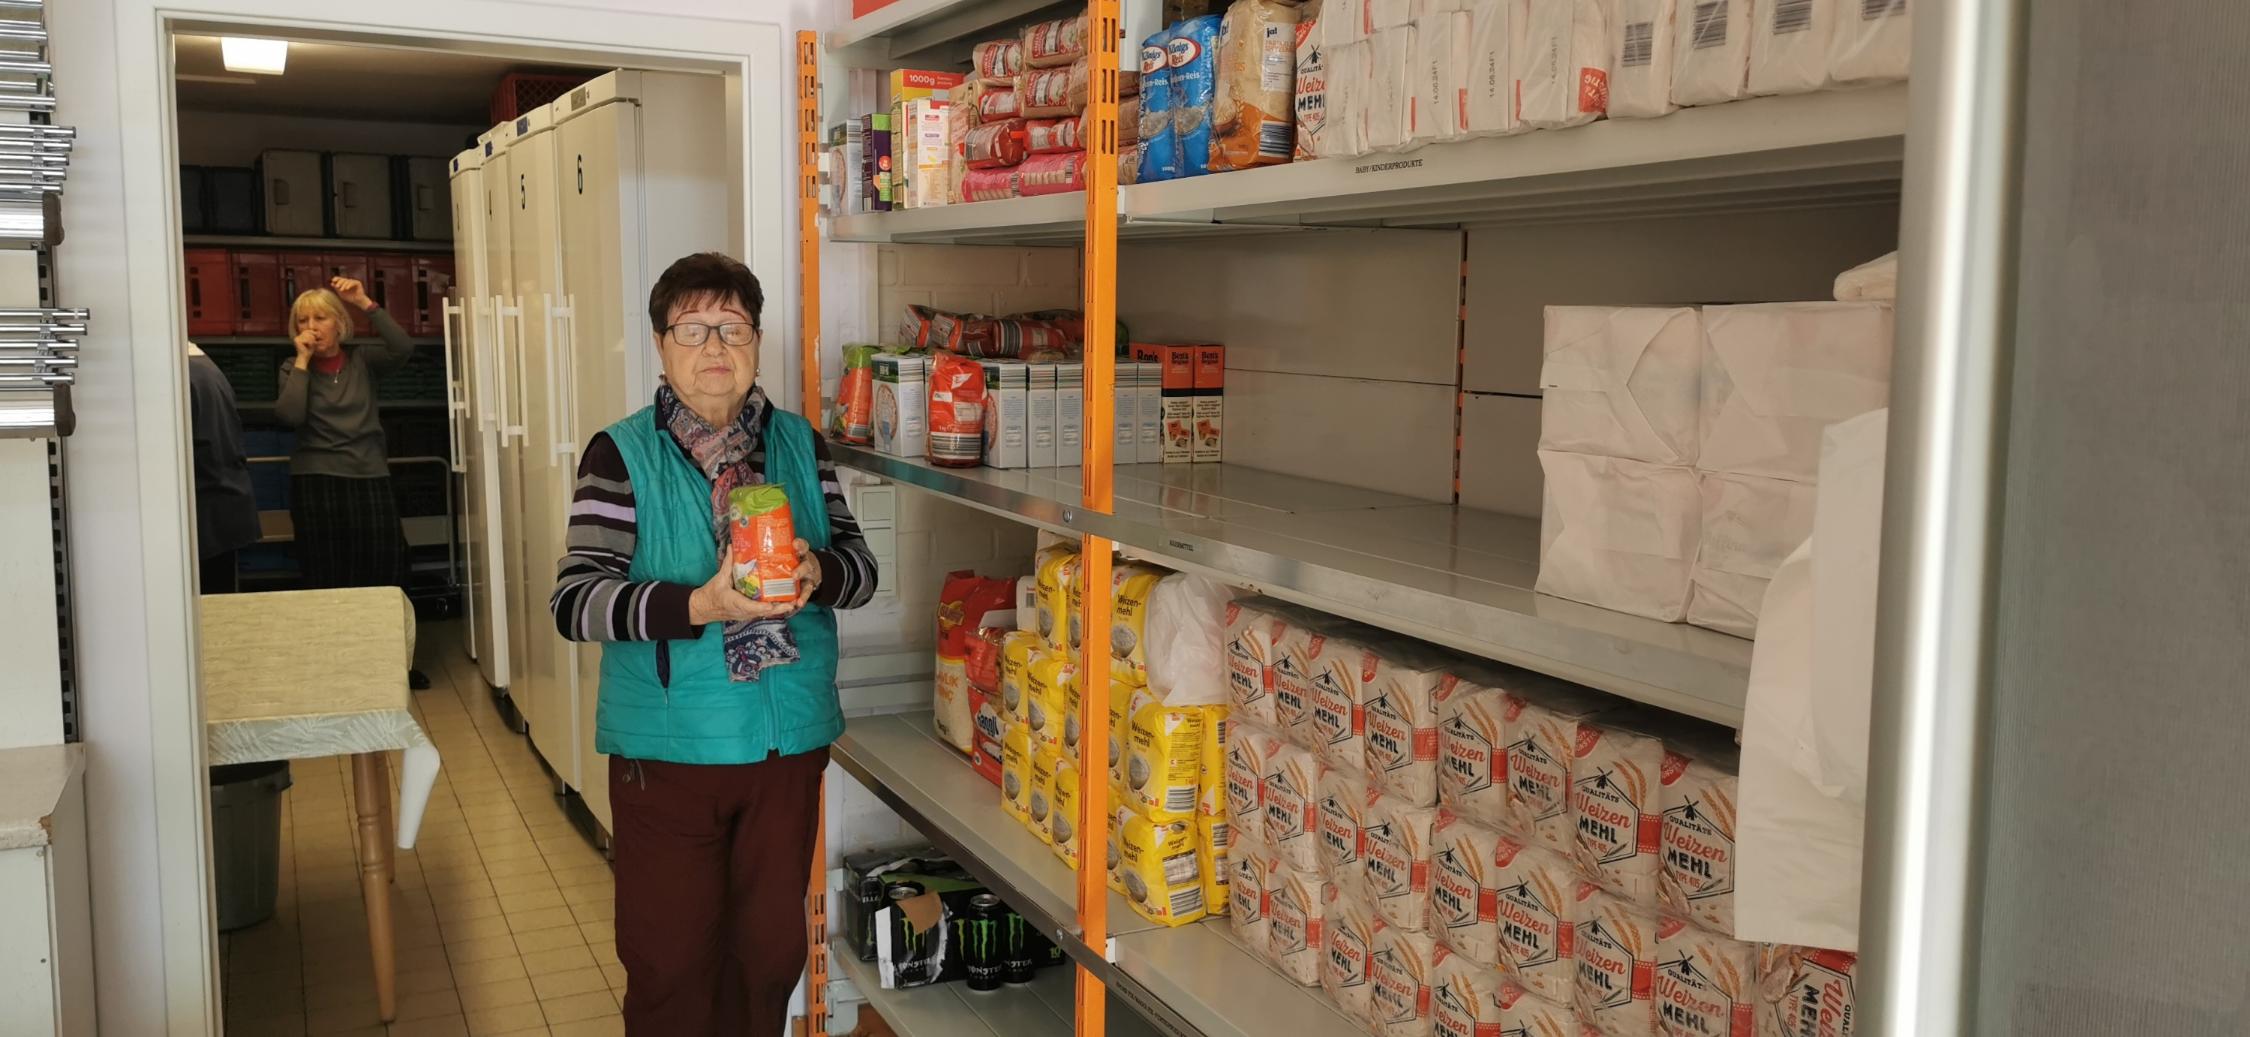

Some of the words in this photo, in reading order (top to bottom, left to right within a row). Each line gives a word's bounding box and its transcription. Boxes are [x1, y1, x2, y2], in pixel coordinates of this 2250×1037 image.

[909, 74, 935, 86] 1000g
[577, 154, 583, 195] 6
[520, 173, 526, 211] 5
[1231, 671, 1254, 690] MEHL
[1277, 690, 1302, 710] MEHL
[1310, 687, 1348, 716] Weizen
[1314, 706, 1340, 729] MEHL
[1366, 711, 1407, 741] Weizen
[1370, 731, 1399, 754] MEHL
[1510, 753, 1560, 788] Weizen
[1518, 775, 1551, 800] MEHL
[1582, 785, 1620, 804] QUALITÄTS
[1268, 804, 1293, 826] MEHL
[1575, 791, 1632, 829] Weizen
[1578, 815, 1618, 845] MEHL
[1669, 815, 1712, 836] QUALITÄTS
[1364, 833, 1407, 871] Weizen
[1663, 821, 1728, 864] Weizen
[1367, 858, 1396, 883] MEHL
[1667, 846, 1713, 880] MEHL
[1434, 884, 1463, 913] MEHL
[1498, 899, 1552, 936] Weizen
[1503, 921, 1540, 950] MEHL
[1331, 946, 1353, 974] MEHL
[1575, 936, 1627, 976] Weizen
[1578, 960, 1613, 991] MEHL
[1657, 975, 1725, 1018] Weizen
[1662, 1000, 1710, 1035] MEHL
